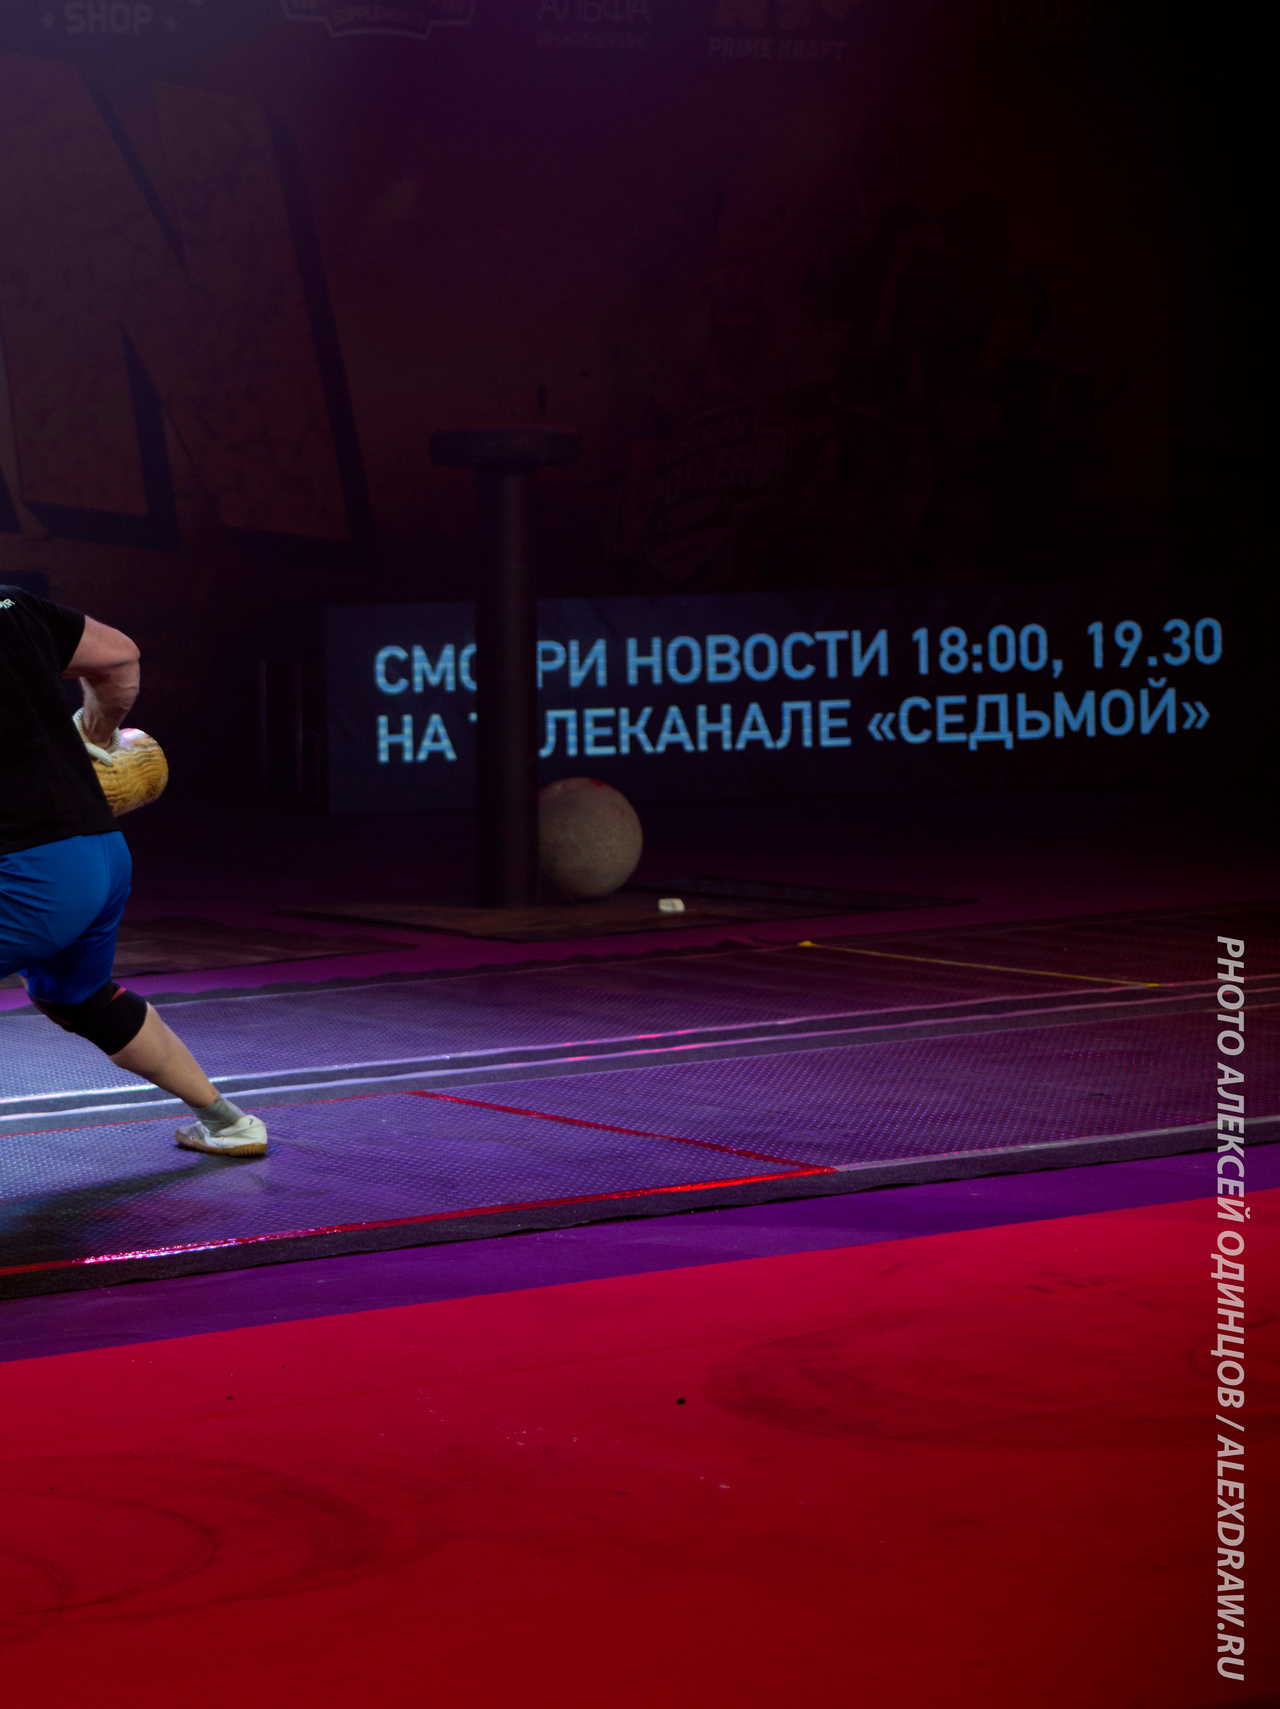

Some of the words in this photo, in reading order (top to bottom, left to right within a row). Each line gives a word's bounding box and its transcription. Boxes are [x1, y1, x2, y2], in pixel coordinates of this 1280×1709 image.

[64, 1, 154, 35] SHOP
[707, 36, 775, 59] PRIME
[777, 38, 848, 62] KRAFT
[375, 639, 608, 694] СМОРИ
[627, 630, 888, 686] НОВОСТИ
[913, 624, 1063, 679] 18:00,
[1088, 618, 1222, 669] 19.30
[377, 714, 457, 763] НА
[469, 700, 852, 759] ЛЕКАНАЛЕ
[868, 678, 1209, 752] «СЕДЬМОЙ»
